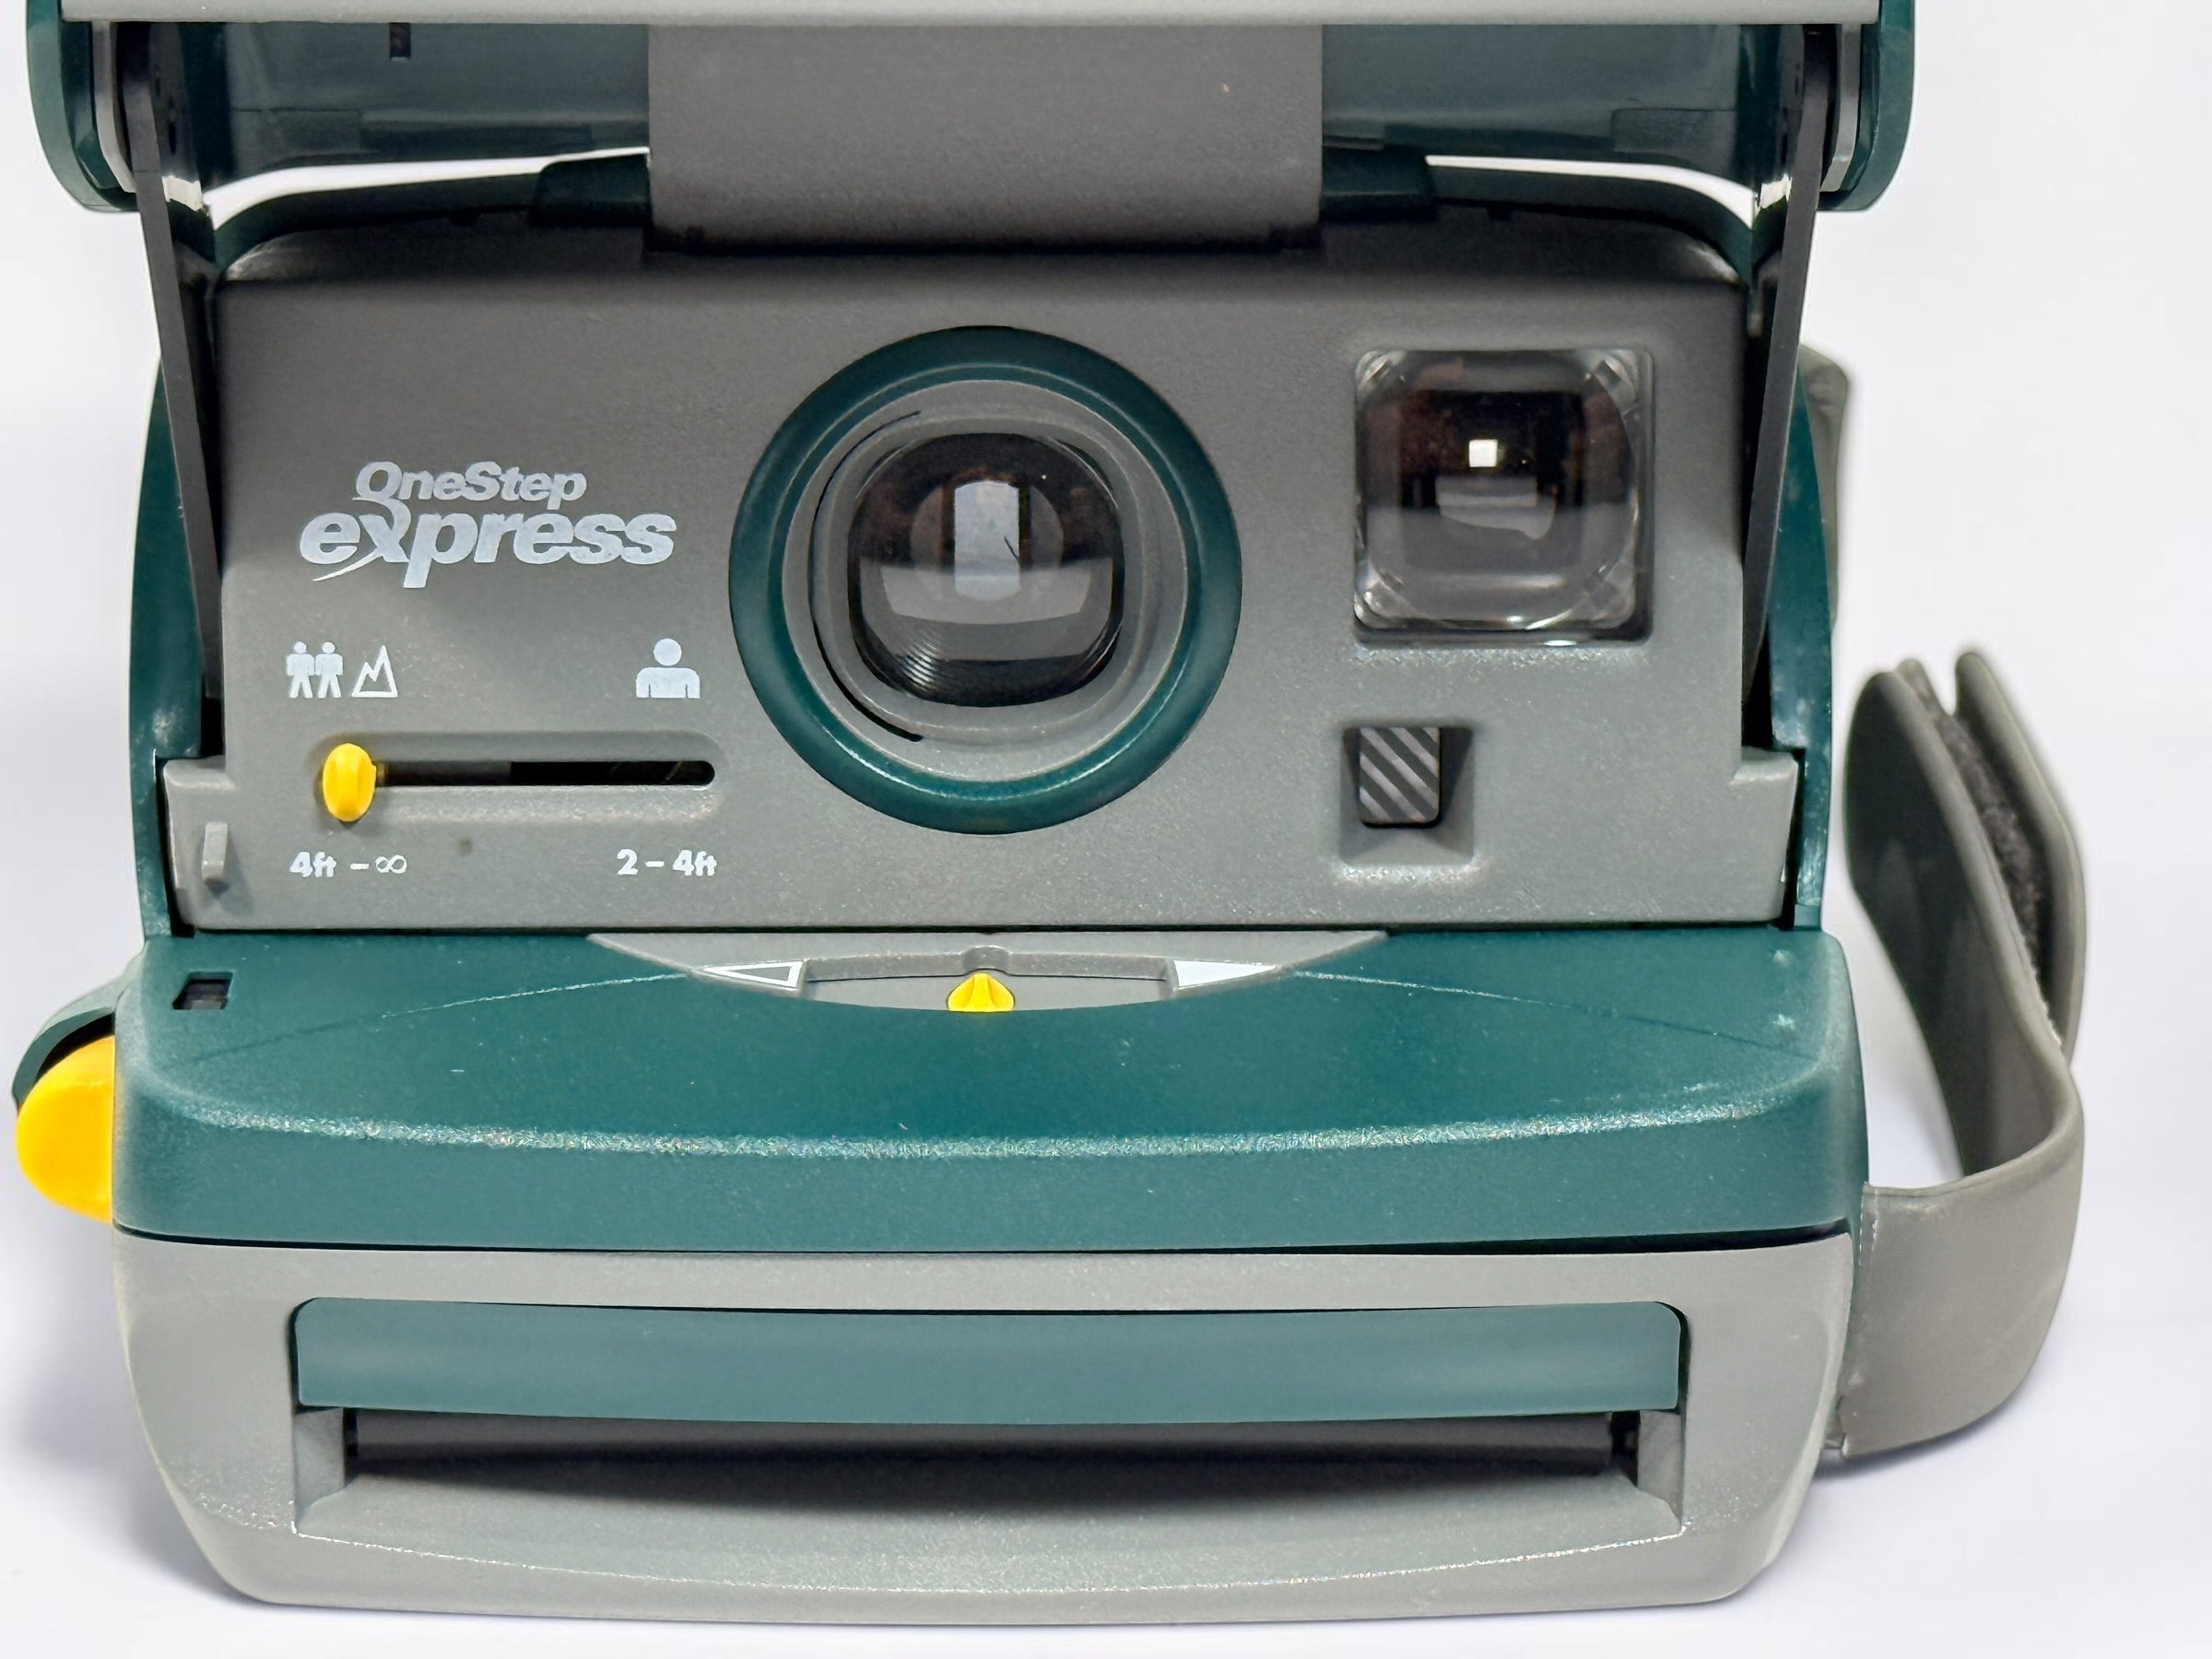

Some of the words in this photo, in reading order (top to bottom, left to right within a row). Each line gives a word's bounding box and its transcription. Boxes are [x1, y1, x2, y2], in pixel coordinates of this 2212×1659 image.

[352, 461, 588, 511] OneStep
[299, 511, 677, 589] express
[288, 852, 337, 877] 4ft
[616, 848, 639, 876] 2
[672, 850, 718, 877] 4ft
